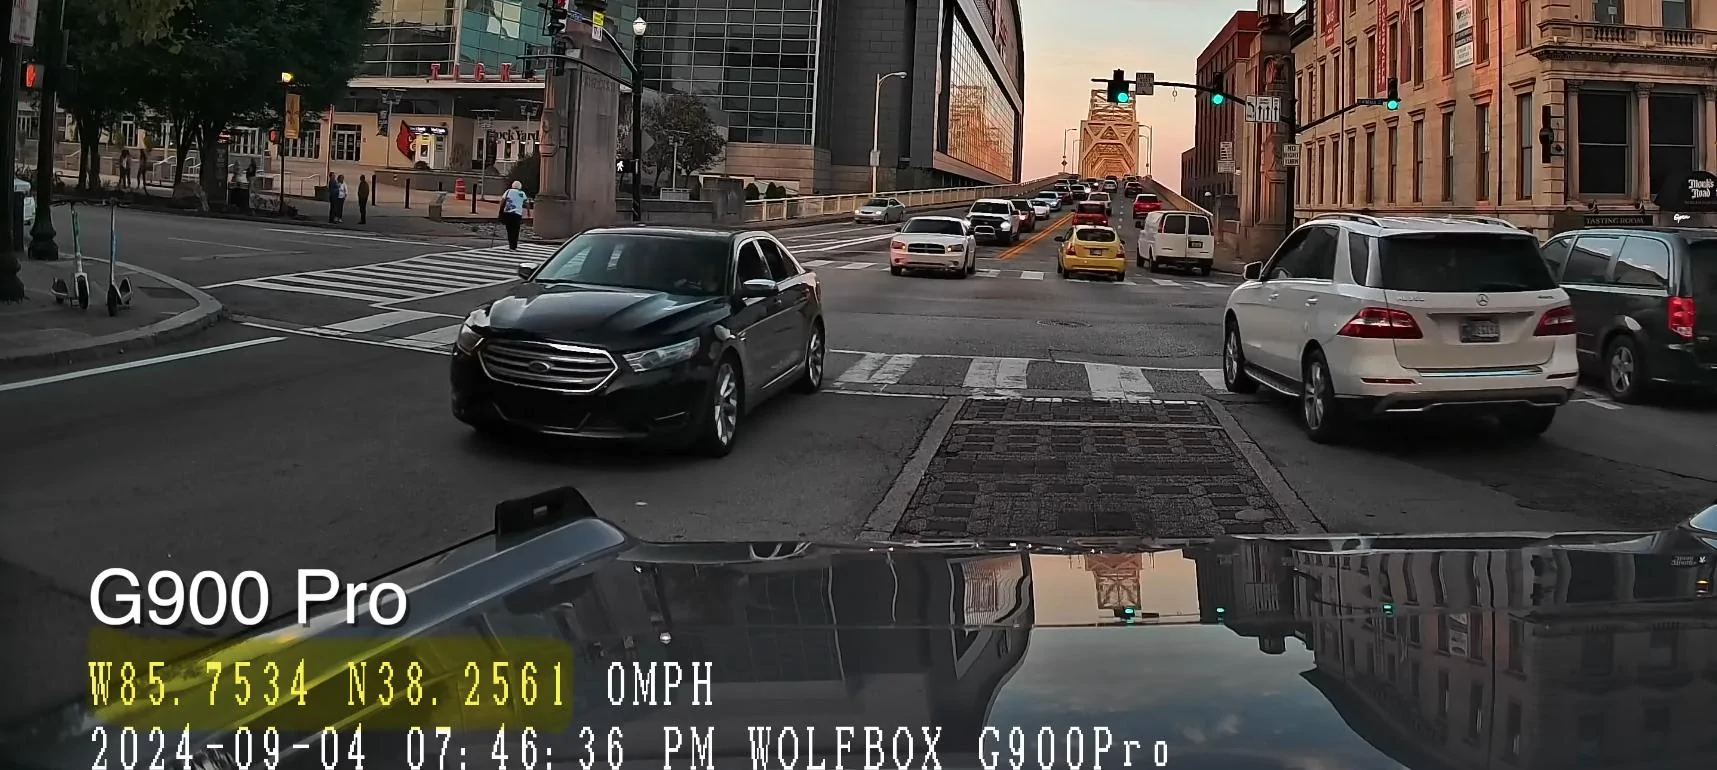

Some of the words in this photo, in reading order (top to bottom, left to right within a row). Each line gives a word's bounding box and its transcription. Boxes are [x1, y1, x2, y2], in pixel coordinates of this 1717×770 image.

[1688, 178, 1715, 189] Monk's
[1586, 216, 1620, 225] TASTING
[1620, 216, 1644, 225] ROOM
